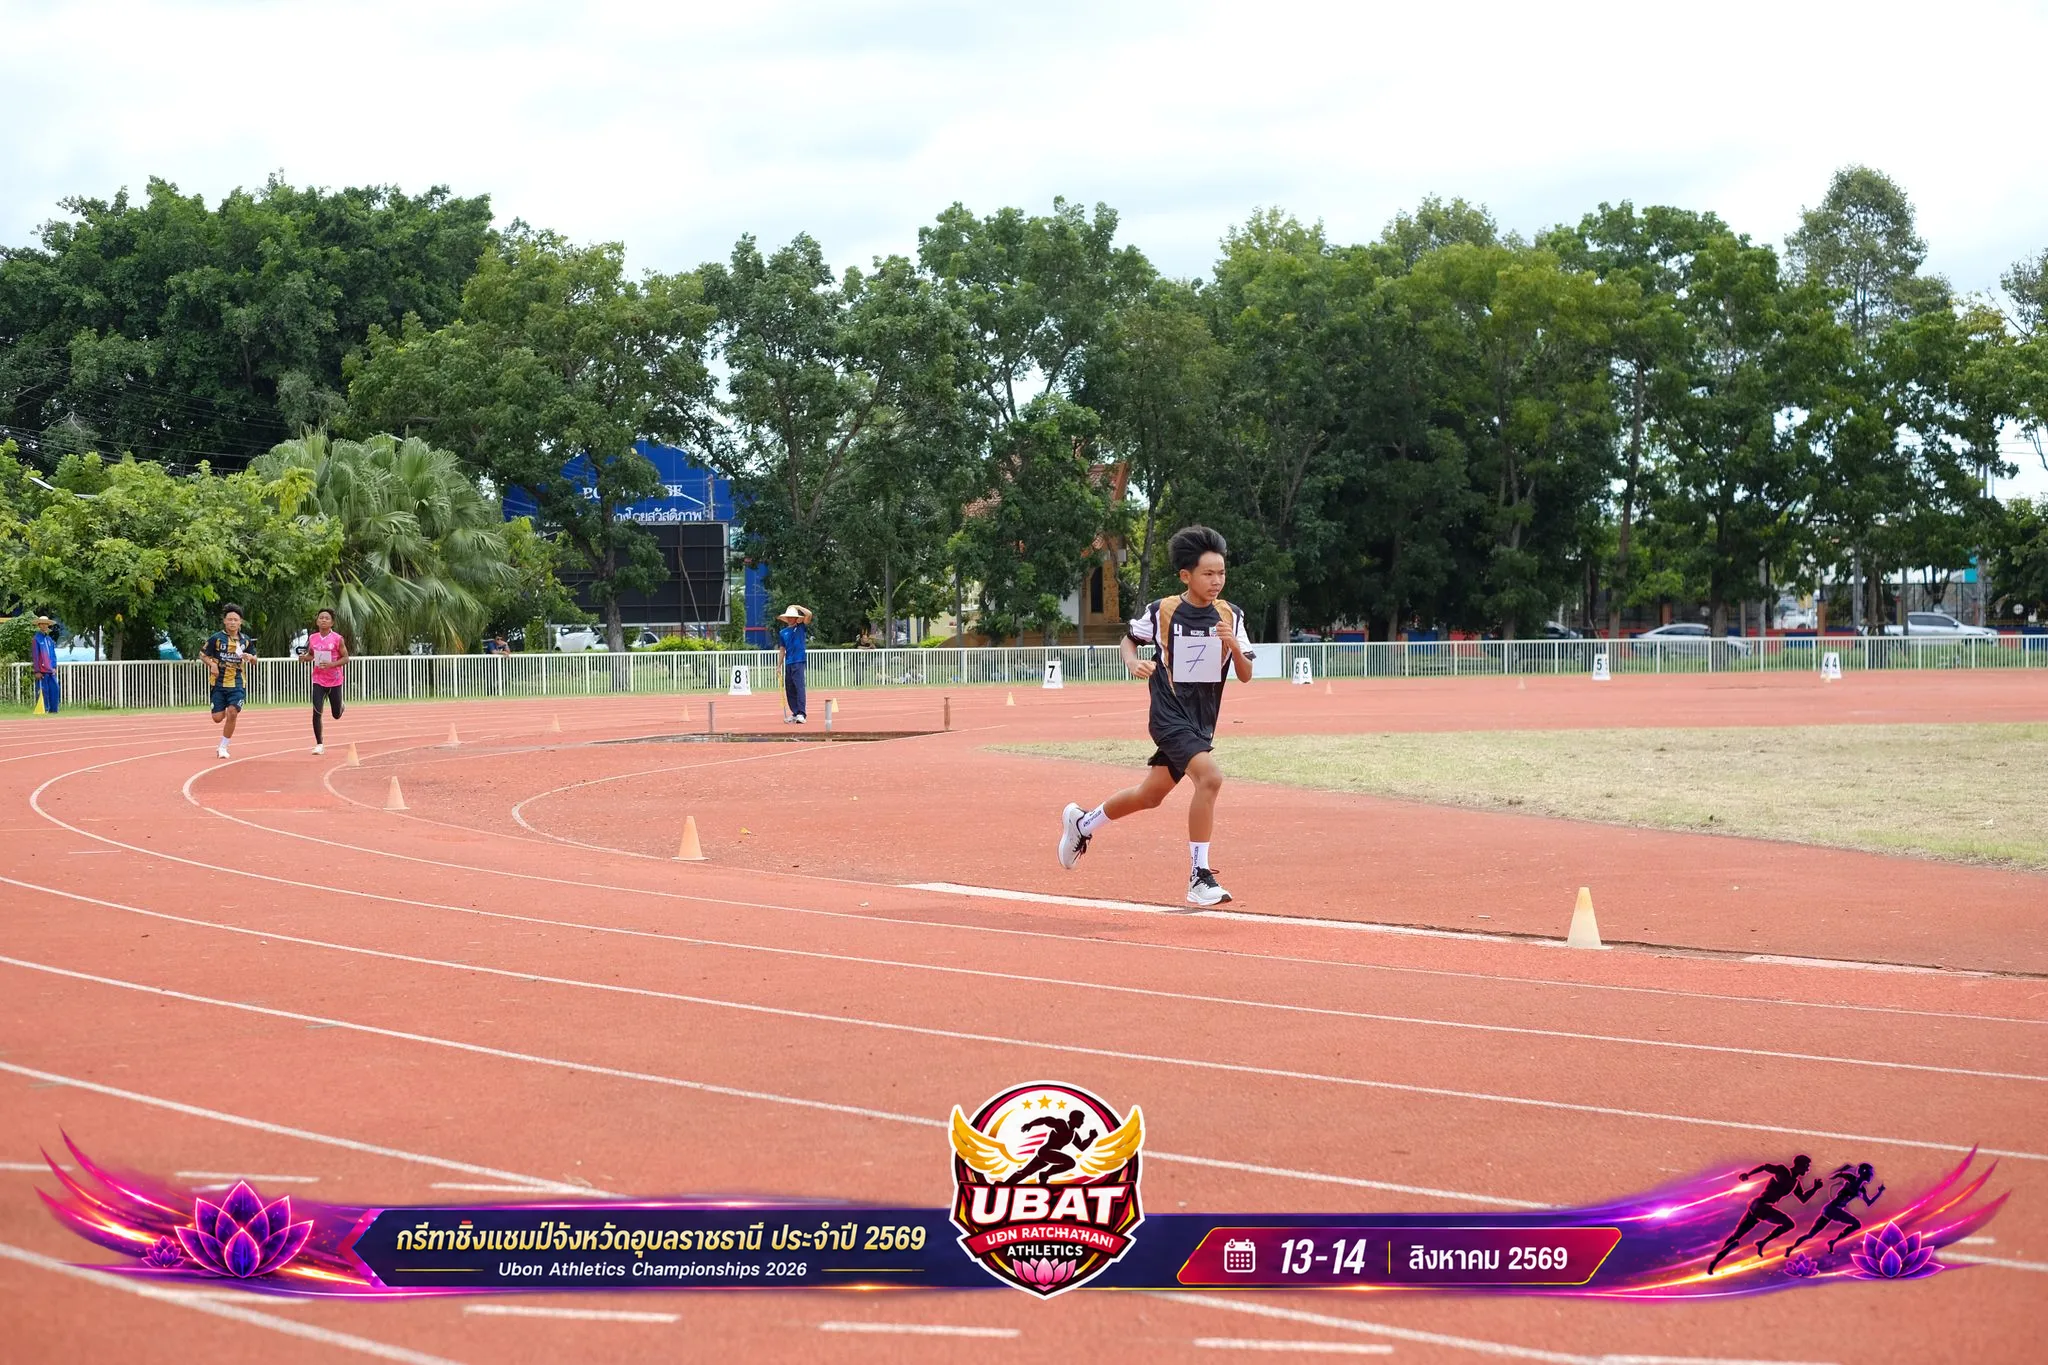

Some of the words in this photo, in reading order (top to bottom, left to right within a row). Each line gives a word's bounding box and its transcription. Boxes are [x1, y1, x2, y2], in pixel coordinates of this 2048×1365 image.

[1185, 644, 1207, 673] 7
[1596, 658, 1603, 671] 5
[1832, 657, 1838, 670] 4
[1048, 665, 1056, 679] 7
[1295, 661, 1300, 675] 6
[1302, 661, 1309, 675] 6
[734, 669, 742, 684] 8
